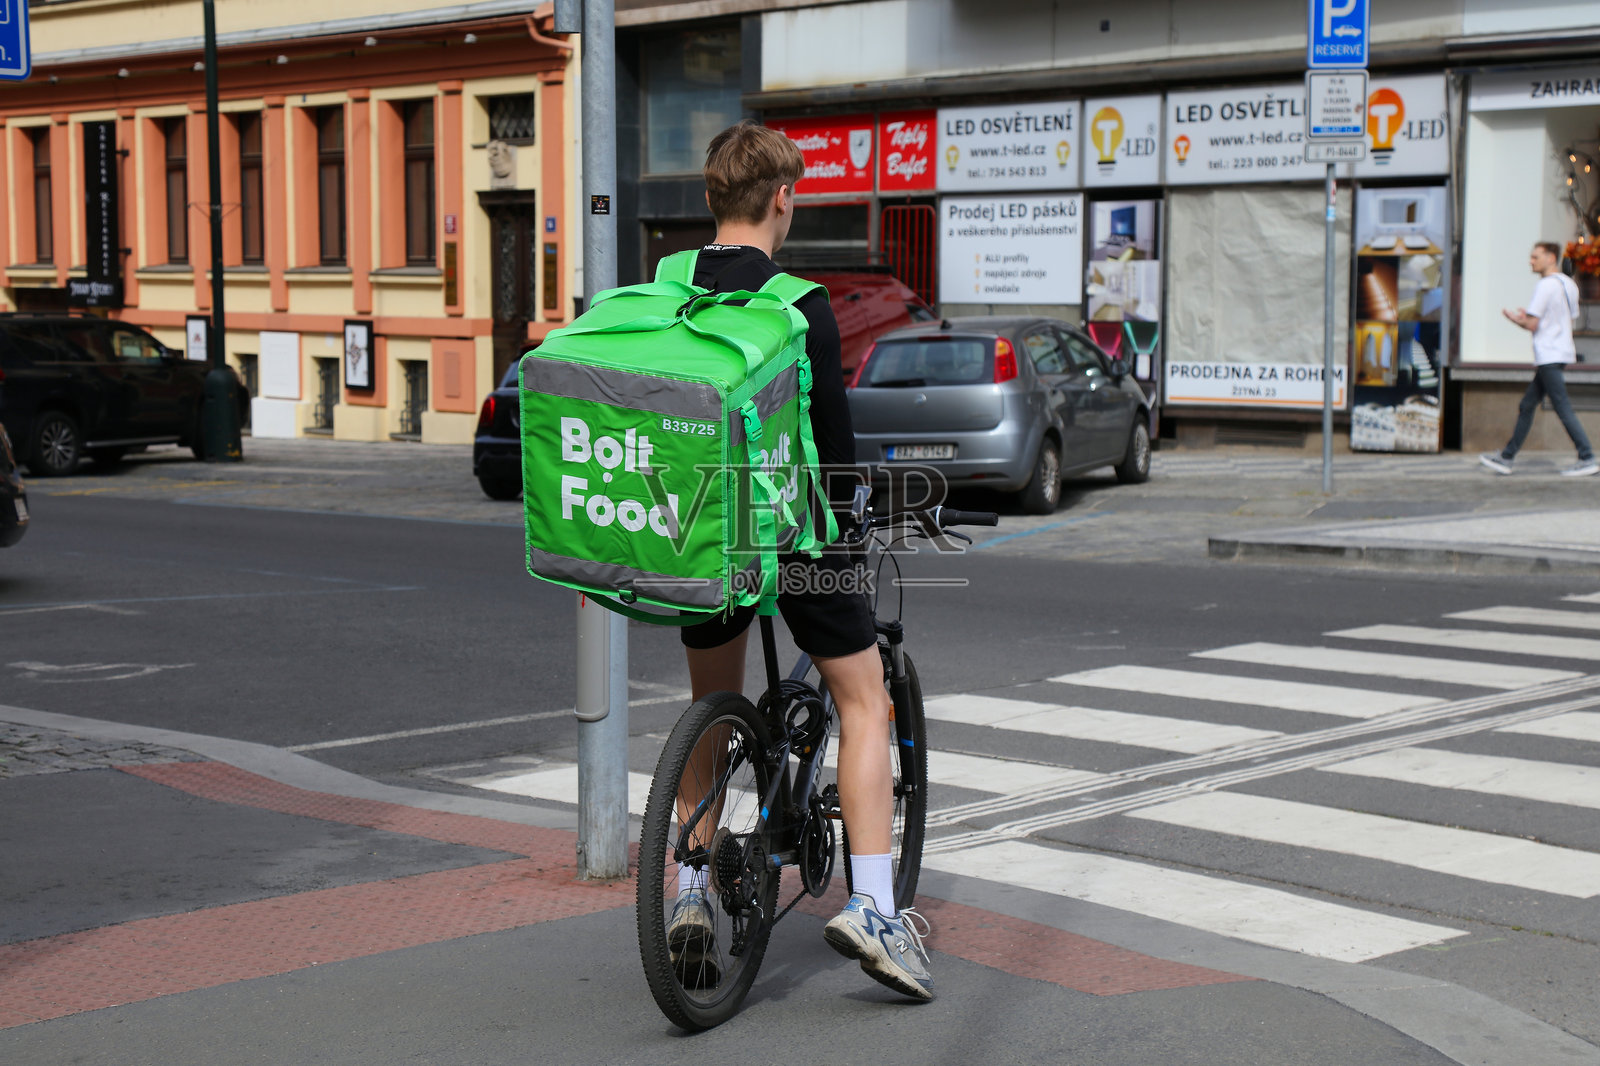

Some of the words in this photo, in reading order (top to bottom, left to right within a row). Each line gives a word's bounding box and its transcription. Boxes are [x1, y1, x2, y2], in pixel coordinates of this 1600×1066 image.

[1176, 104, 1213, 123] LED
[1220, 92, 1306, 121] OSVĚTL
[946, 119, 976, 136] LED
[981, 107, 1073, 134] OSVĚTLENÍ
[1210, 130, 1304, 147] www.t-led.cz
[970, 144, 1047, 158] www.t-led.cz
[1233, 157, 1253, 169] 223
[1257, 156, 1278, 168] 000
[1282, 155, 1303, 167] 247
[886, 152, 928, 181] Bufet
[949, 202, 996, 221] Prodej
[1000, 203, 1028, 219] LED
[1033, 199, 1077, 220] pásků
[1170, 364, 1253, 380] PRODEJNA
[1258, 366, 1279, 381] ZA
[662, 418, 716, 436] B33725
[561, 416, 654, 476] Bolt
[561, 474, 679, 539] Food
